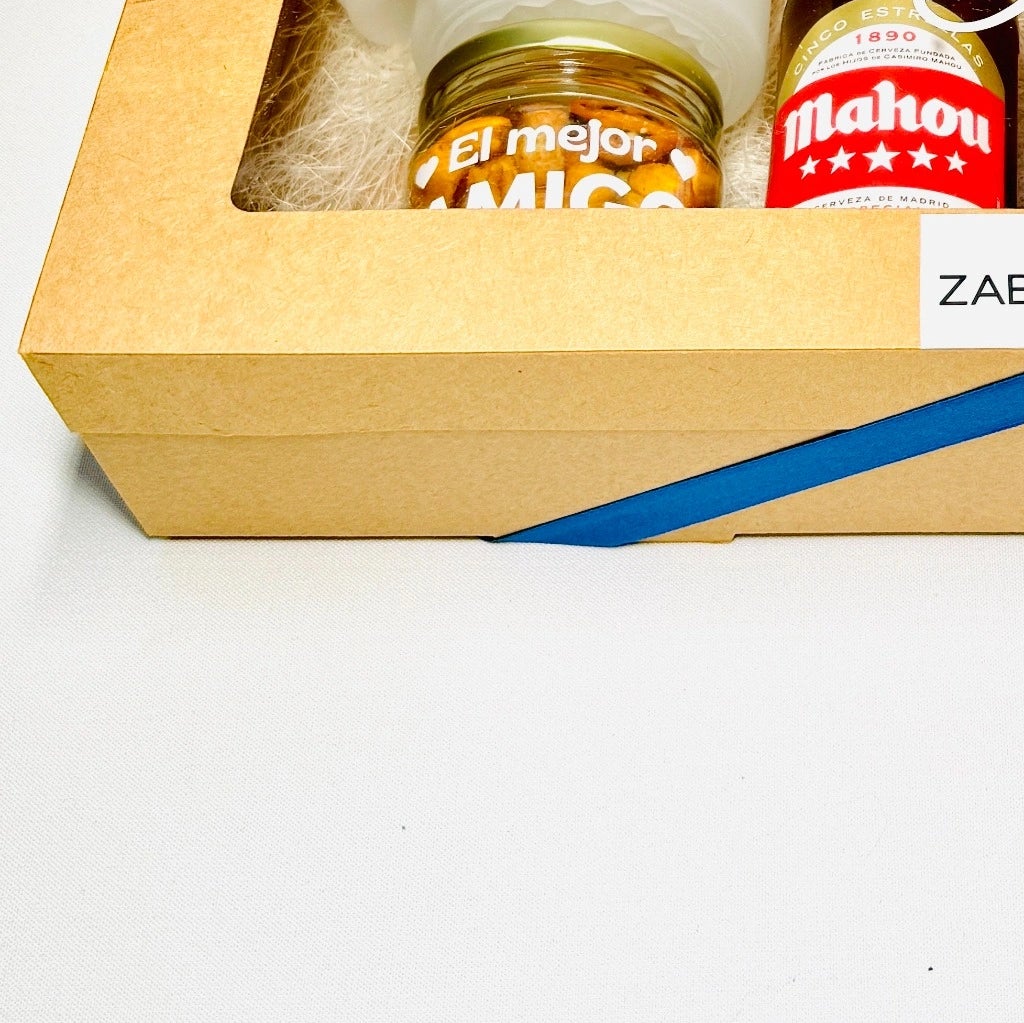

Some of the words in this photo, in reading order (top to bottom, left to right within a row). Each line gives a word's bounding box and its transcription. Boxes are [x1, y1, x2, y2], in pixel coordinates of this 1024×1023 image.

[794, 19, 848, 76] CINCO
[861, 6, 984, 68] ESTRLAS
[855, 30, 917, 45] 1890
[448, 126, 494, 173] El
[506, 118, 658, 163] mejor
[783, 79, 992, 162] Mahou
[900, 195, 950, 208] MADRID
